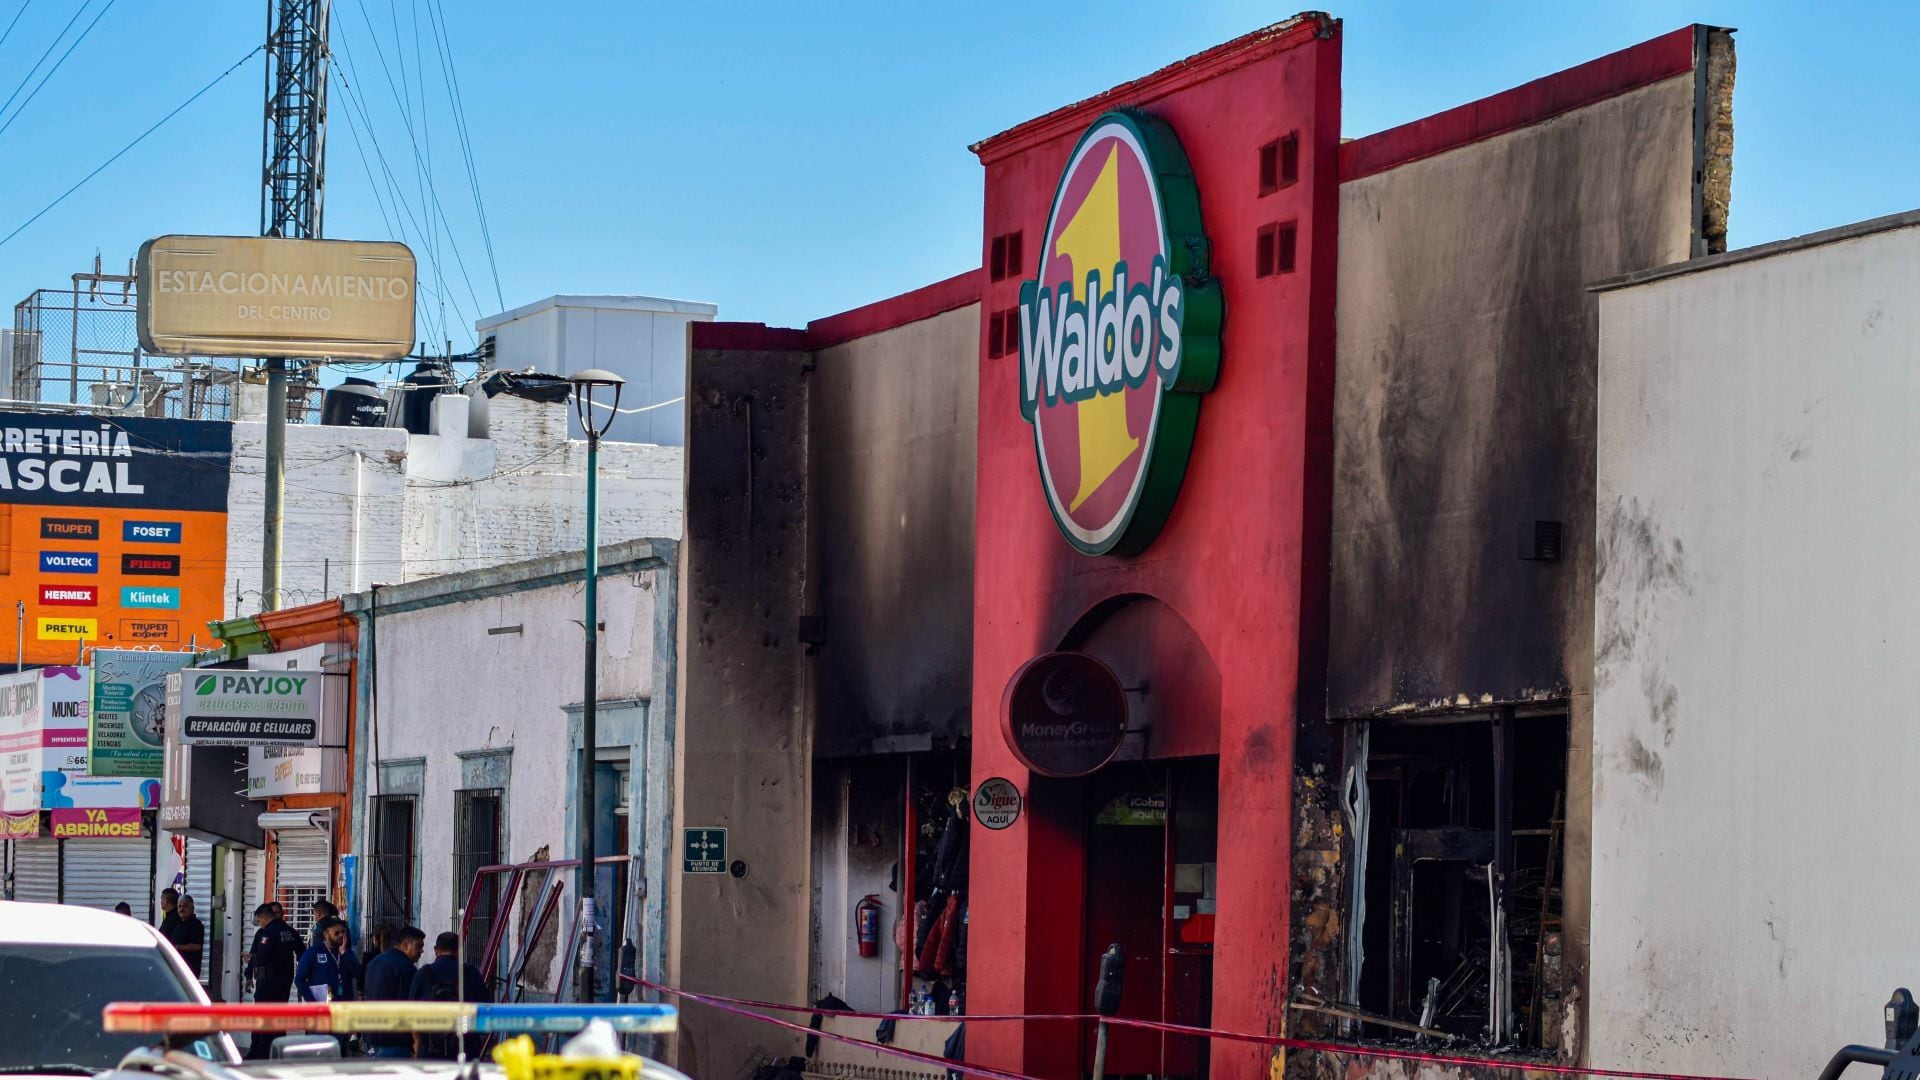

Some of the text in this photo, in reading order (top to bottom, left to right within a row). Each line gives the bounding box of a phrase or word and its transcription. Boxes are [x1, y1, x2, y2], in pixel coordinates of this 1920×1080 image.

[158, 270, 408, 299] ESTACIONAMIENTO
[238, 304, 332, 321] DEL CENTRO
[1020, 266, 1180, 401] Waldo's
[0, 424, 132, 457] RETERÍA
[47, 523, 93, 534] TRUPER
[133, 526, 171, 537] FOSET
[130, 559, 172, 570] FIERO
[44, 590, 92, 600] HERMEX
[130, 592, 170, 604] Klintek
[45, 624, 89, 634] PRETUL
[131, 623, 169, 631] TRUPER
[132, 631, 168, 639] expert
[223, 676, 307, 695] PAYJOY
[190, 720, 247, 732] REPARACIÓN
[250, 722, 261, 732] DE
[263, 722, 311, 734] CELULARES
[1021, 721, 1111, 737] MoneyGr
[979, 786, 1017, 809] Sigue
[86, 809, 108, 822] YA
[987, 815, 1009, 823] AQUÍ
[54, 823, 140, 836] ABRIMOS!!
